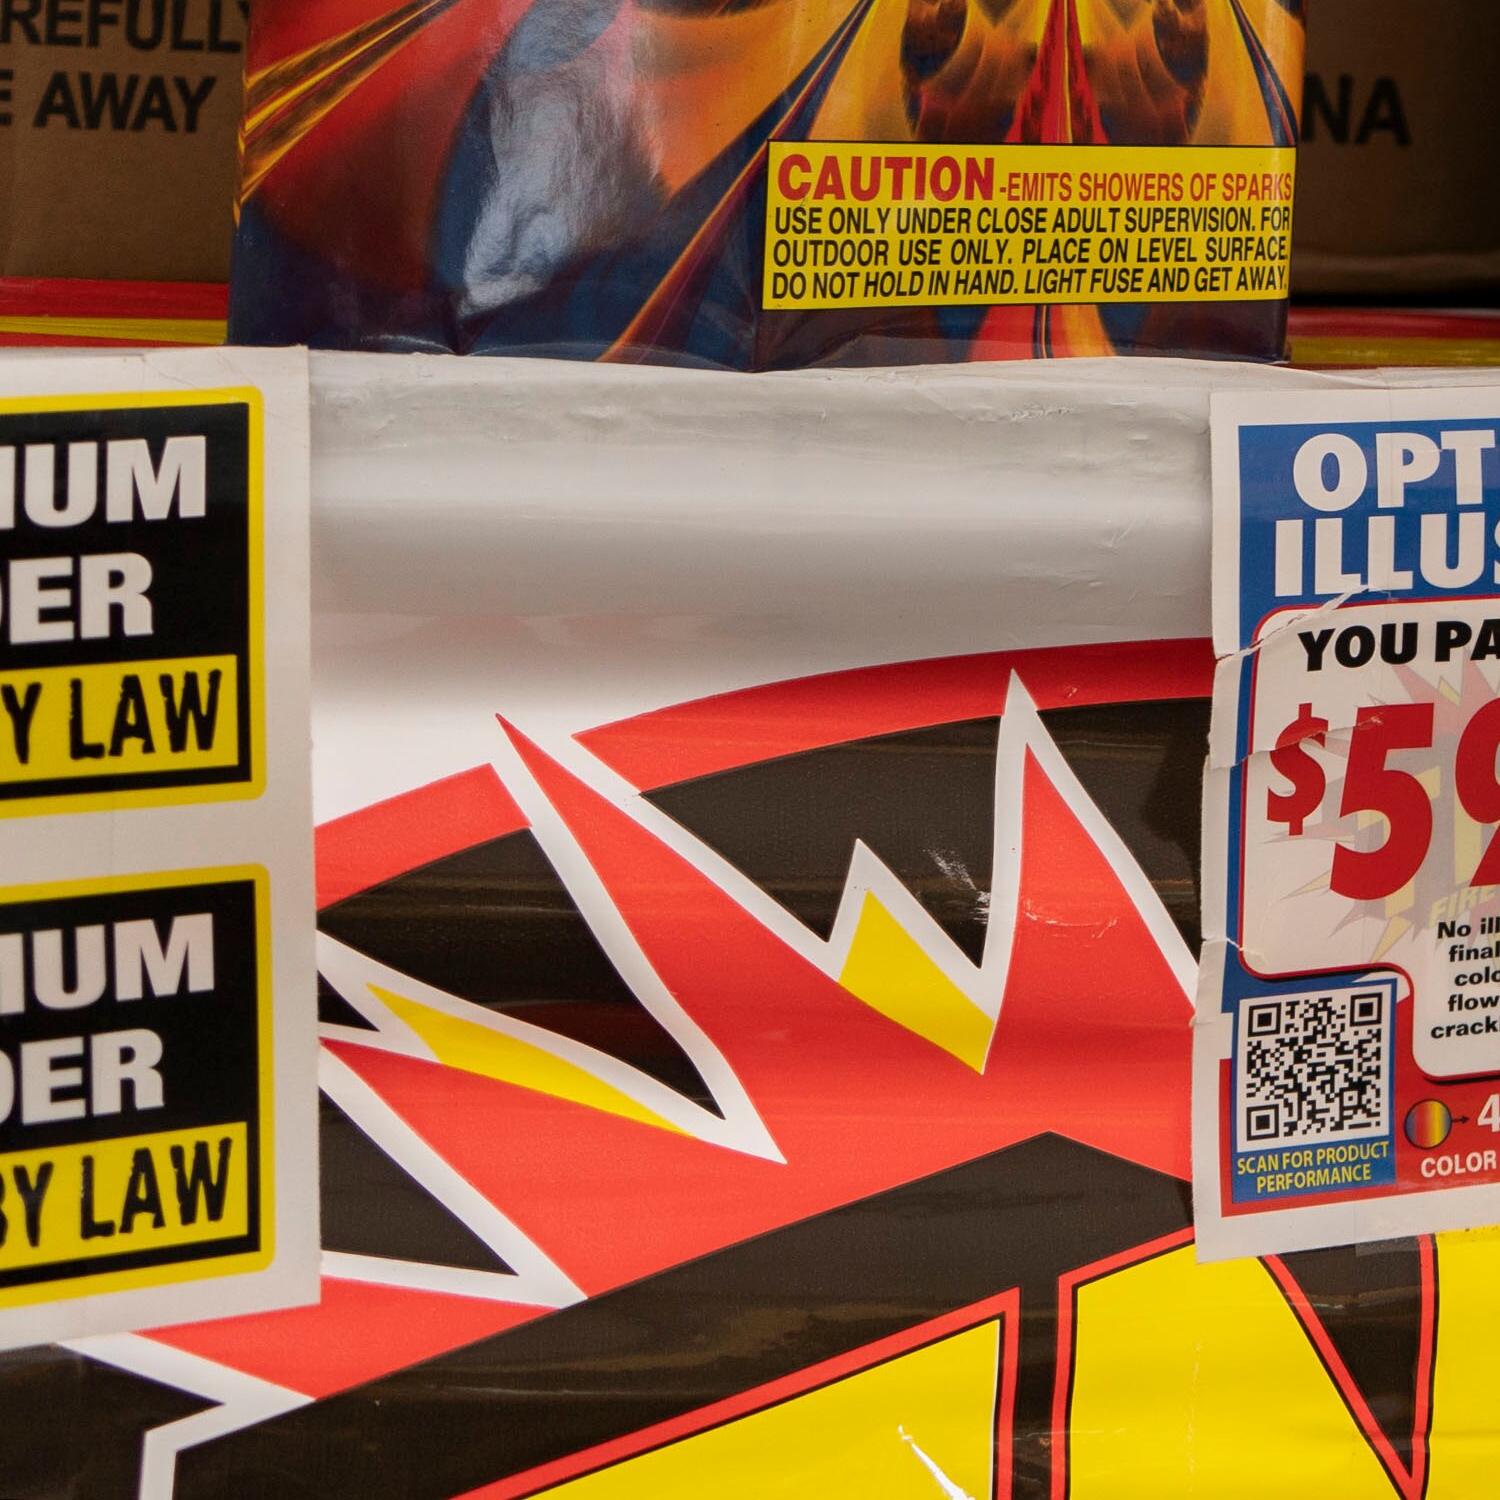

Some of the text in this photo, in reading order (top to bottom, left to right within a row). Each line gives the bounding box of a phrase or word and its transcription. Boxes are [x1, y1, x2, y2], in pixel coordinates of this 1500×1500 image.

[33, 71, 216, 134] AWAY
[777, 153, 995, 202] CAUTION
[1078, 172, 1184, 202] SHOWERS
[1189, 172, 1217, 201] OF
[1221, 172, 1292, 201] SPARKS
[775, 206, 1291, 235] USE ONLY UNDER CLOSE ADULT SUPERVISION. FOR
[773, 235, 1288, 267] OUTDOOR USE ONLY. PLACE ON LEVEL SURFACE.
[772, 265, 1288, 299] DO NOT HOLD IN HAND. LIGHT FUSE AND GET AWAY.
[1297, 620, 1420, 672] YOU
[69, 668, 222, 761] LAW
[1437, 921, 1472, 939] No
[1236, 1140, 1389, 1176] SCAN FOR PRODUCT
[1420, 1149, 1497, 1178] COLOR
[79, 1137, 233, 1240] LAW
[1256, 1162, 1372, 1193] PERFORMANCE
